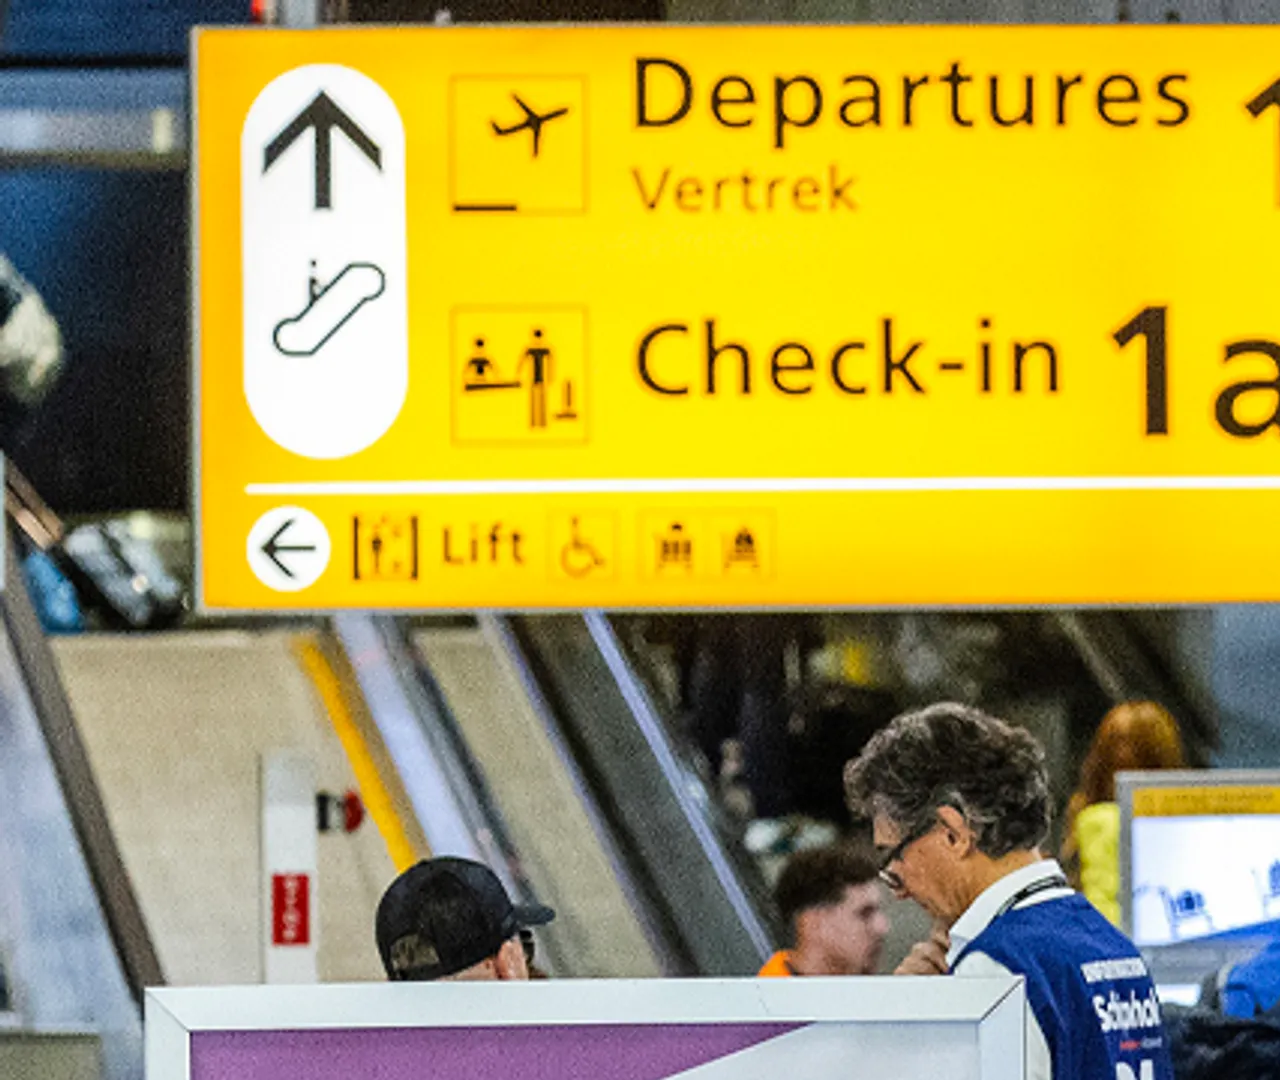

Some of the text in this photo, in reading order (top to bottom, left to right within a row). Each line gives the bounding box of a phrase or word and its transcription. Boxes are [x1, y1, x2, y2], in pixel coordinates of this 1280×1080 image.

[634, 55, 1191, 150] Departures
[630, 163, 859, 213] Vertrek
[636, 316, 1059, 396] Check-in
[442, 521, 524, 566] Lift
